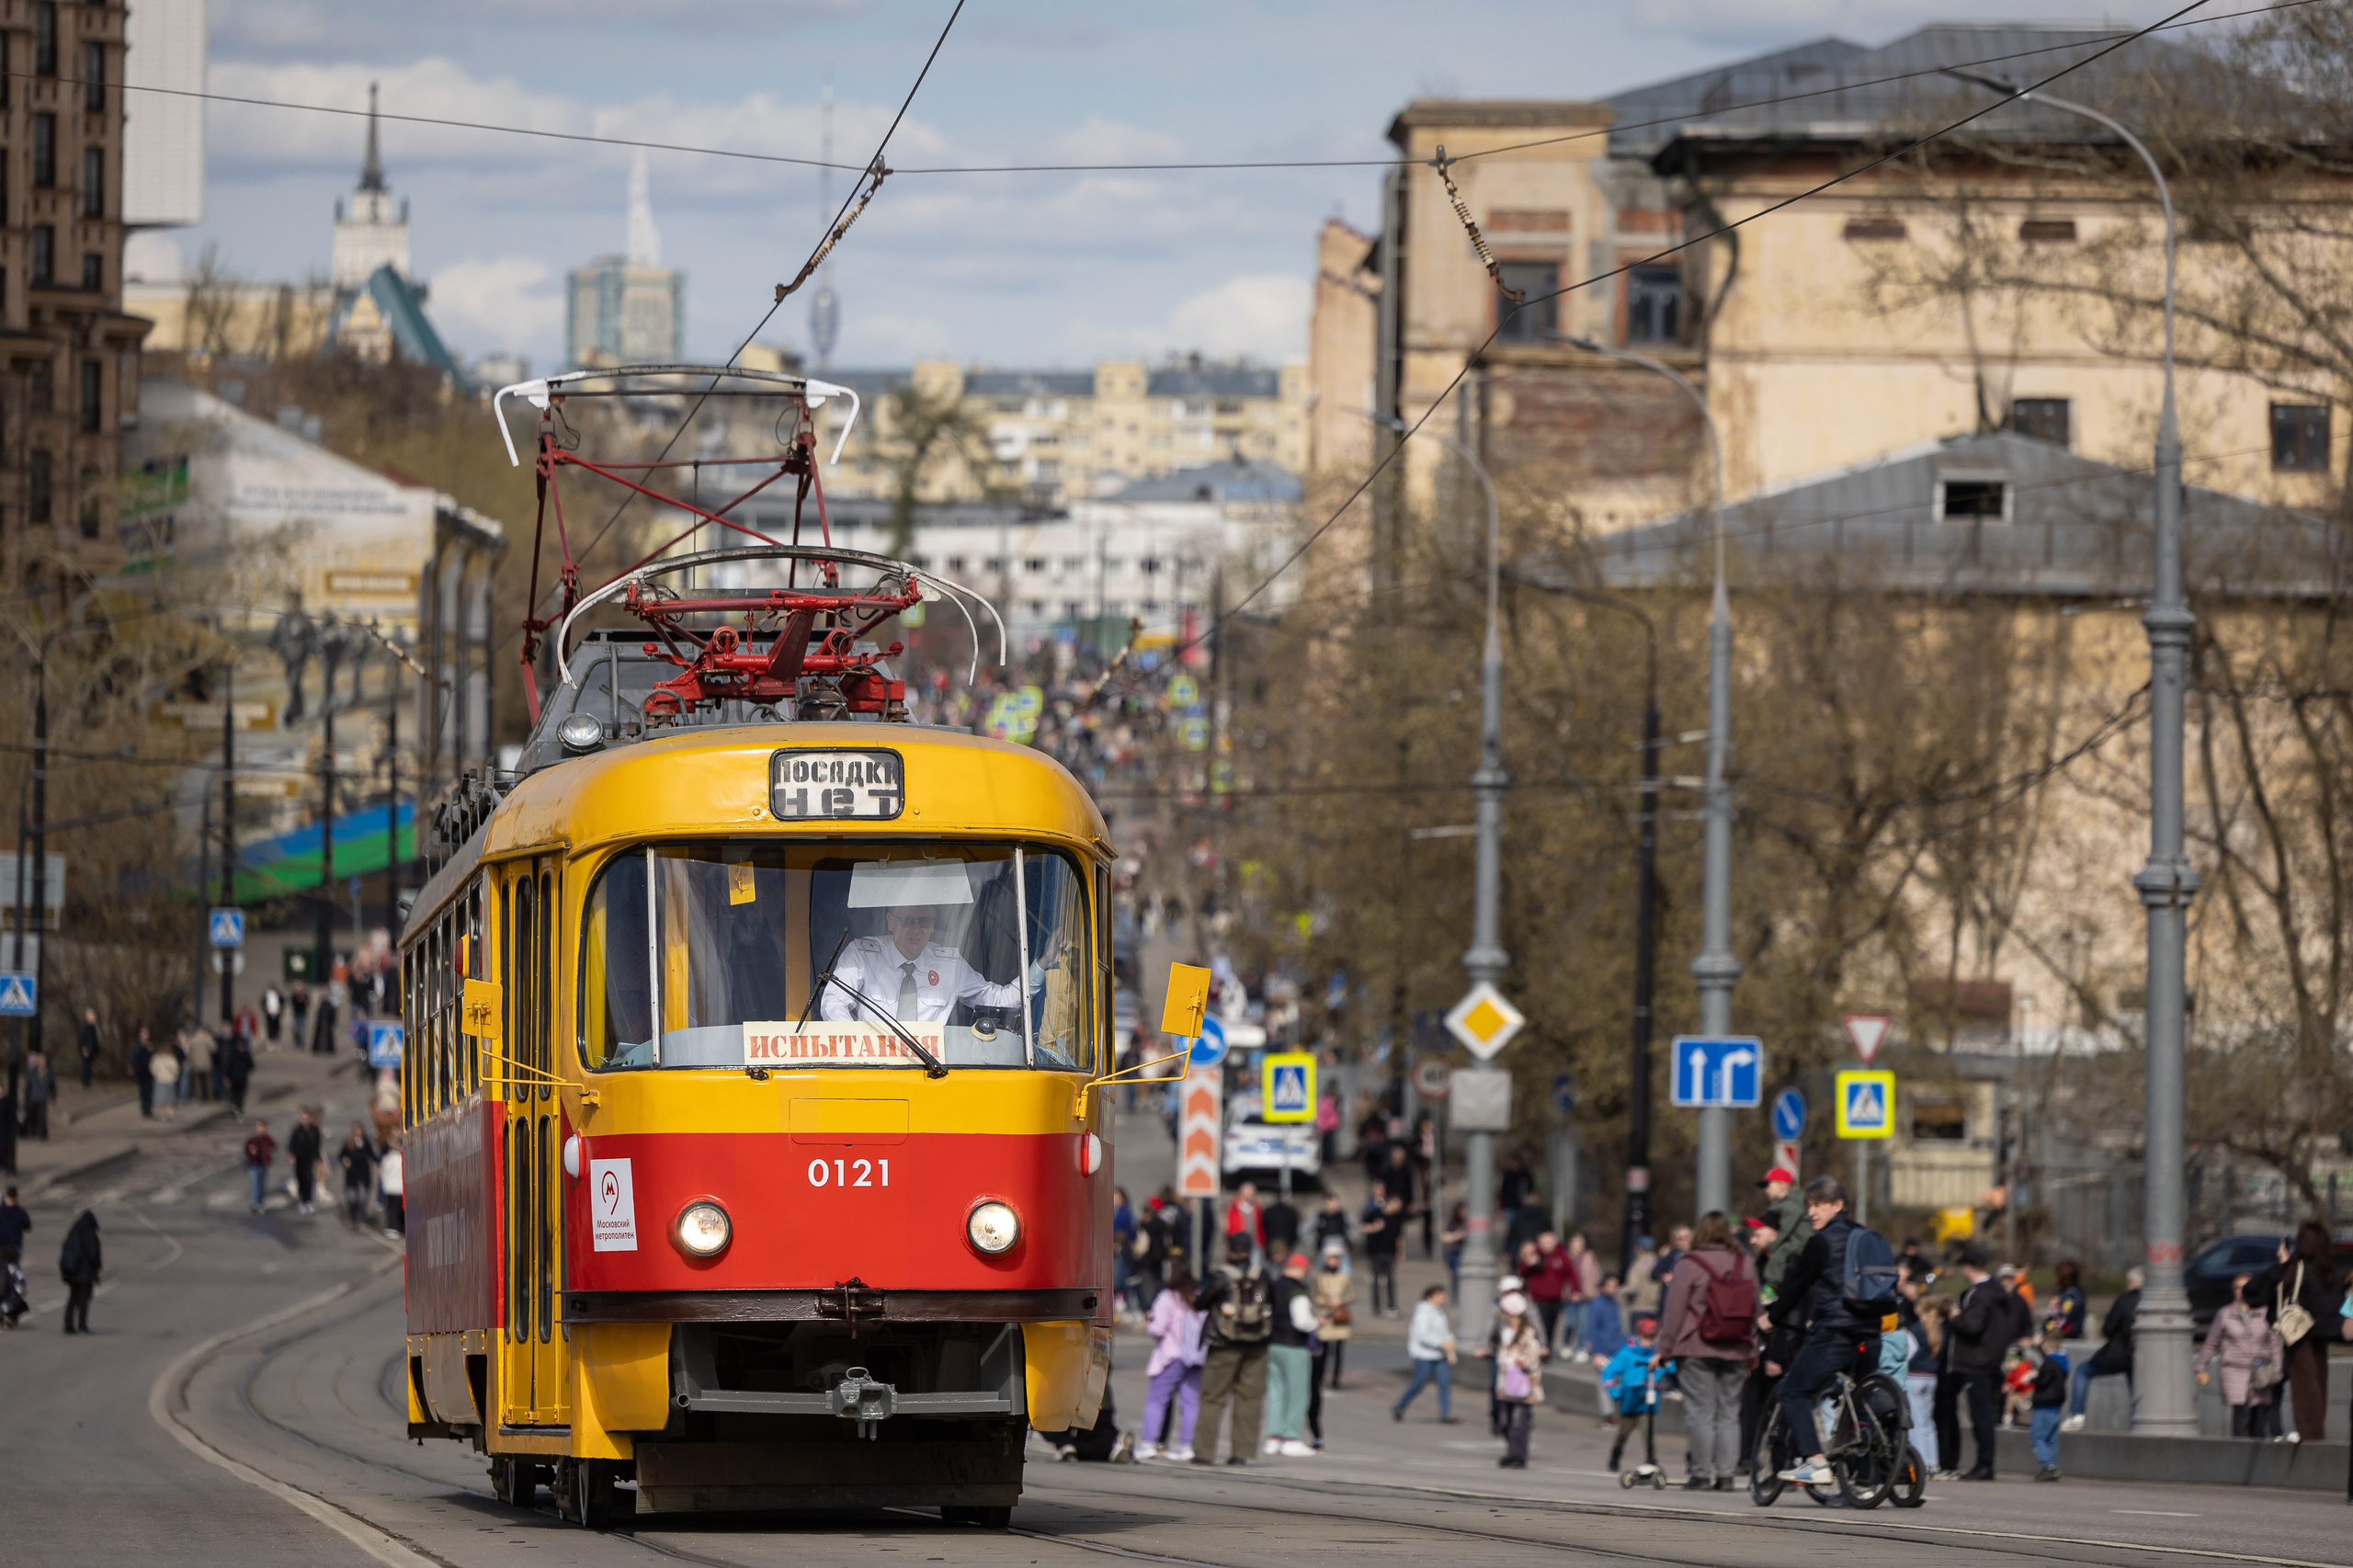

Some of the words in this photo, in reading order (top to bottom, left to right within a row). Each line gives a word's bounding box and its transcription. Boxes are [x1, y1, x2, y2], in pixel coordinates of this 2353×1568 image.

[775, 761, 897, 787] ПОСАДКИ
[808, 1159, 888, 1187] 0121
[597, 1219, 630, 1228] Московский
[595, 1233, 634, 1242] метрополитен
